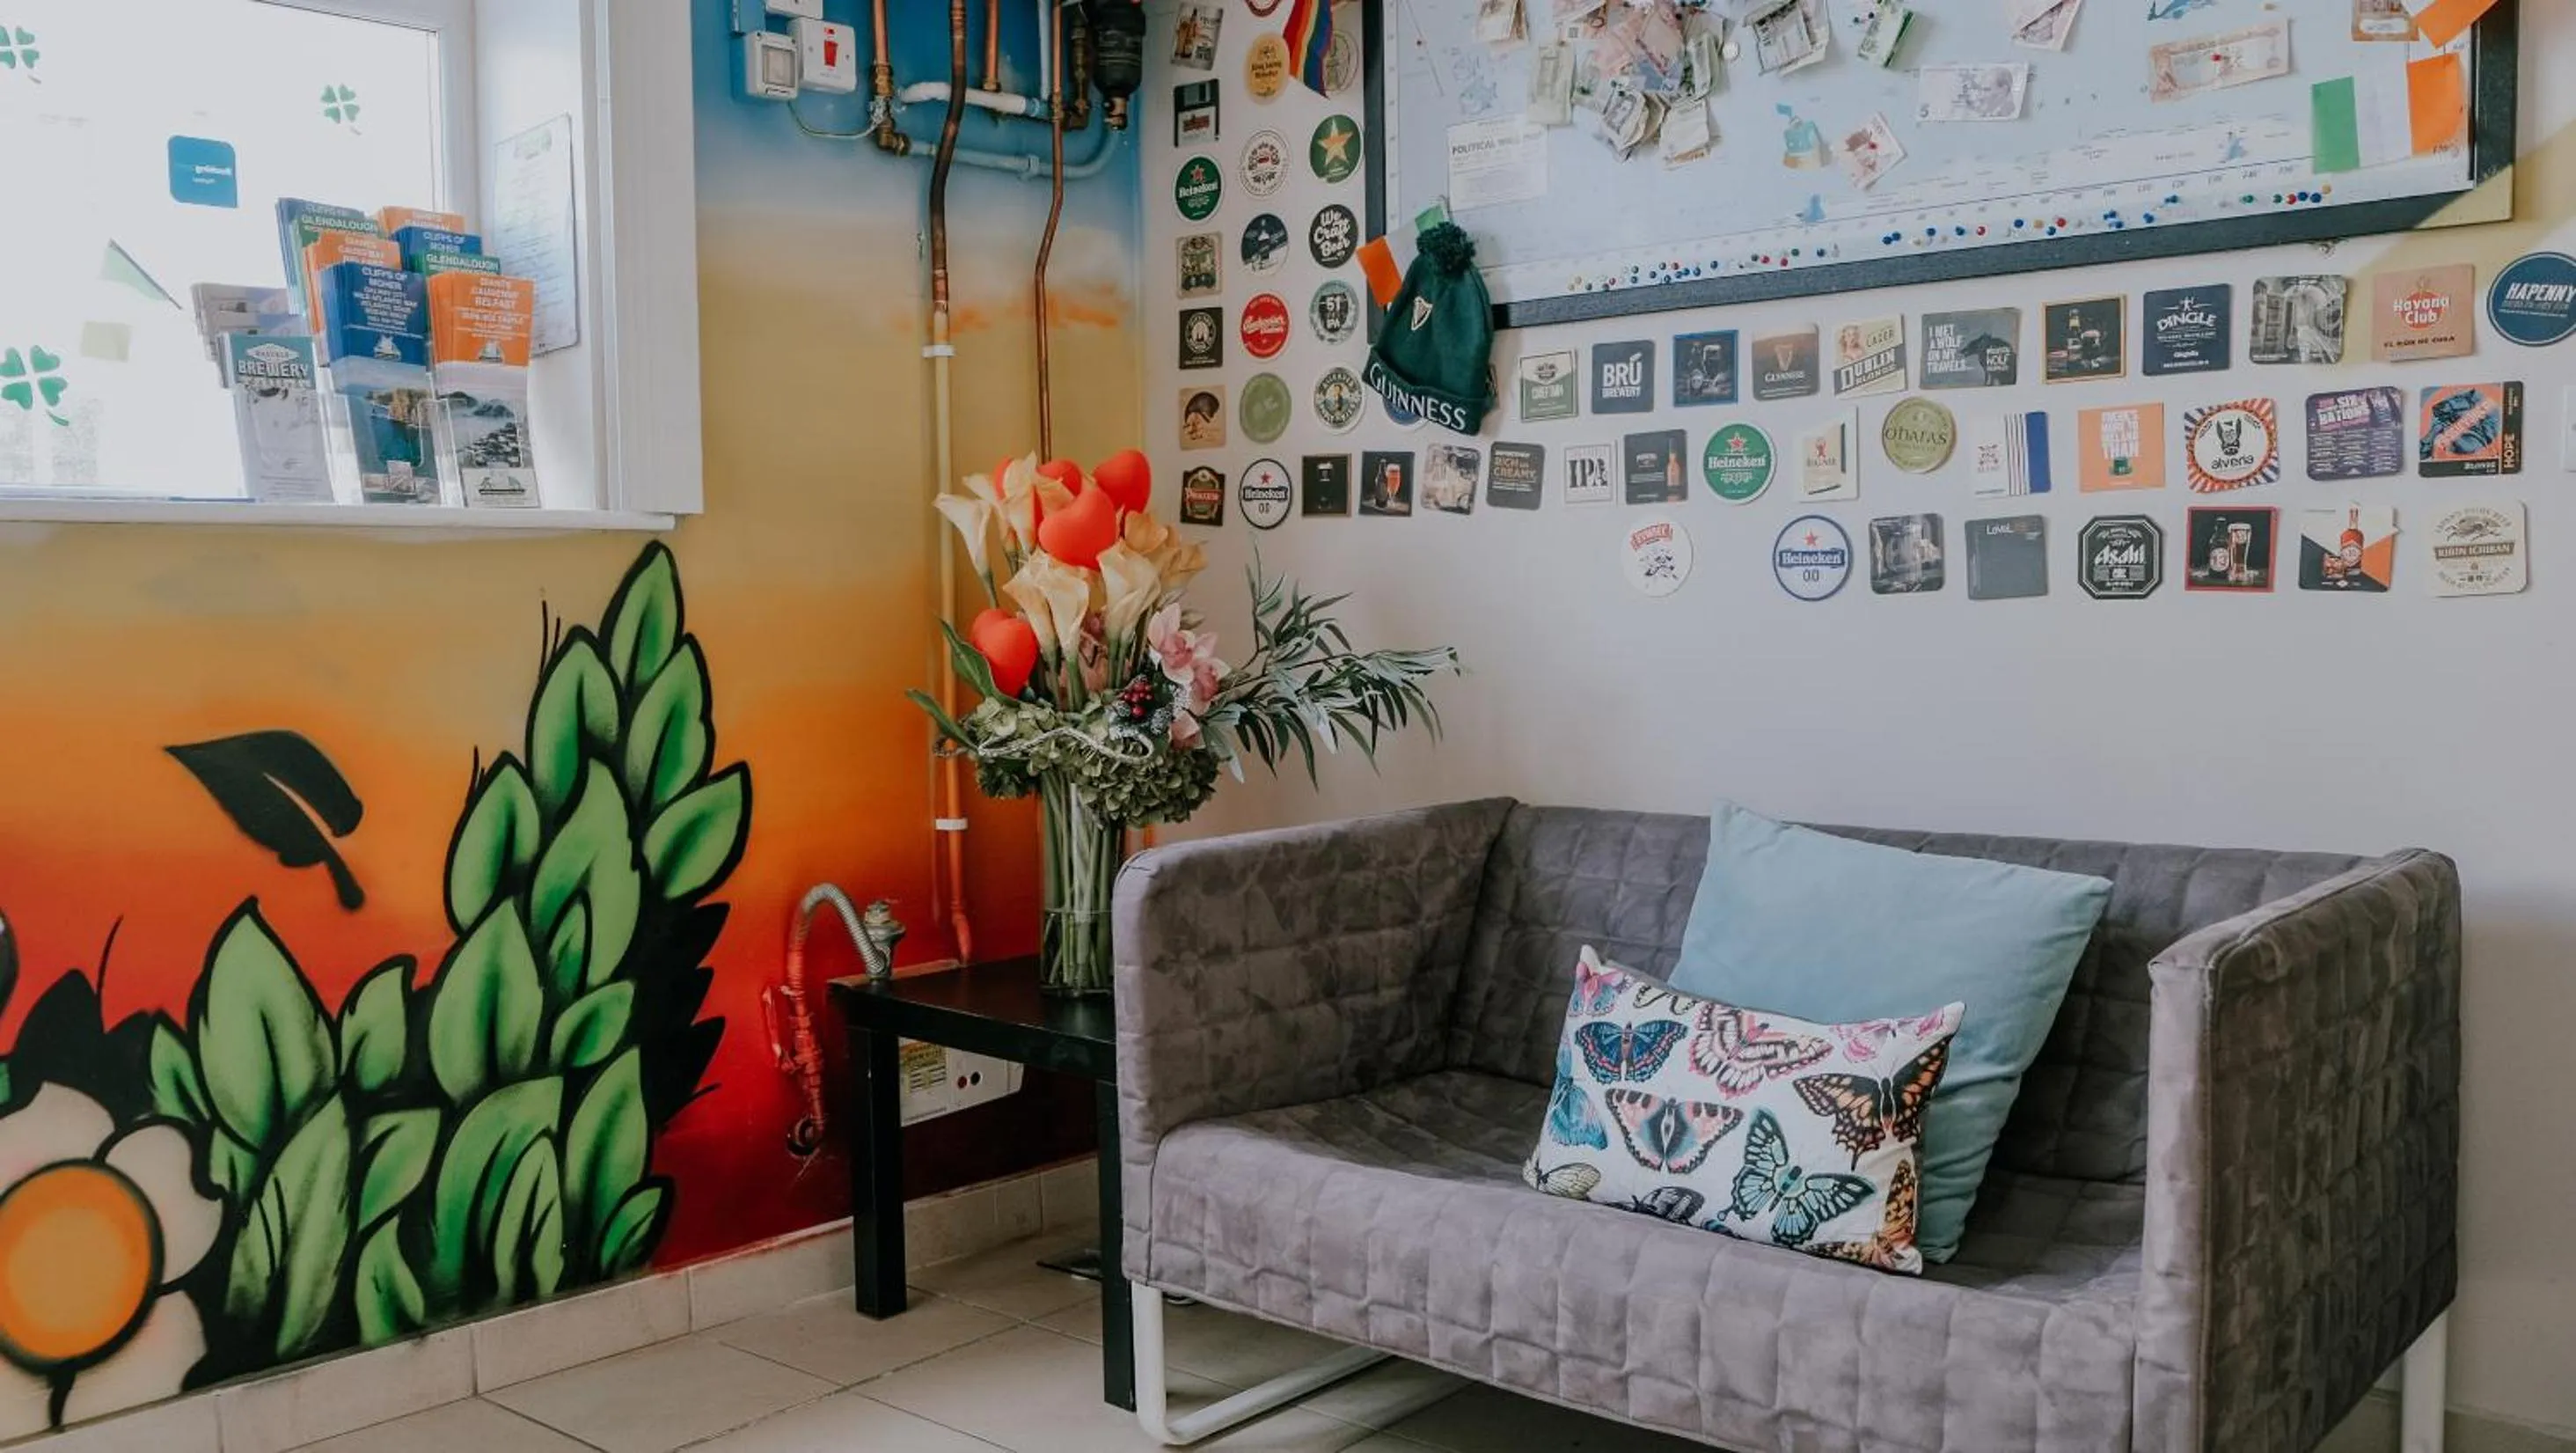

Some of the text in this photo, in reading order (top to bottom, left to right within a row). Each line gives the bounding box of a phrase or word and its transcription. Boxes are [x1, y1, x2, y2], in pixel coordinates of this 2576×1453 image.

[1321, 209, 1343, 226] We
[1314, 219, 1350, 244] Craft
[1321, 235, 1350, 257] Beer
[2393, 296, 2450, 312] Havana
[2156, 312, 2217, 331] DINGLE
[2404, 310, 2438, 325] Club
[1865, 328, 1895, 348] LAGER
[1935, 323, 1955, 337] MET
[1936, 334, 1962, 349] WOLF
[1928, 349, 1941, 361] ON
[238, 359, 309, 378] BREWERY
[1603, 352, 1643, 387] BRÚ
[1370, 362, 1467, 430] GUINNESS
[1602, 386, 1641, 399] BREWERY
[2503, 434, 2516, 468] HOPE
[1708, 454, 1767, 470] Heineken
[1493, 466, 1537, 479] CREAMY
[1567, 458, 1609, 488] IPA
[1244, 488, 1285, 500] Heineken
[1781, 550, 1842, 565] Heineken
[2093, 543, 2146, 566] Asahi
[2469, 544, 2511, 555] ICHIBAN
